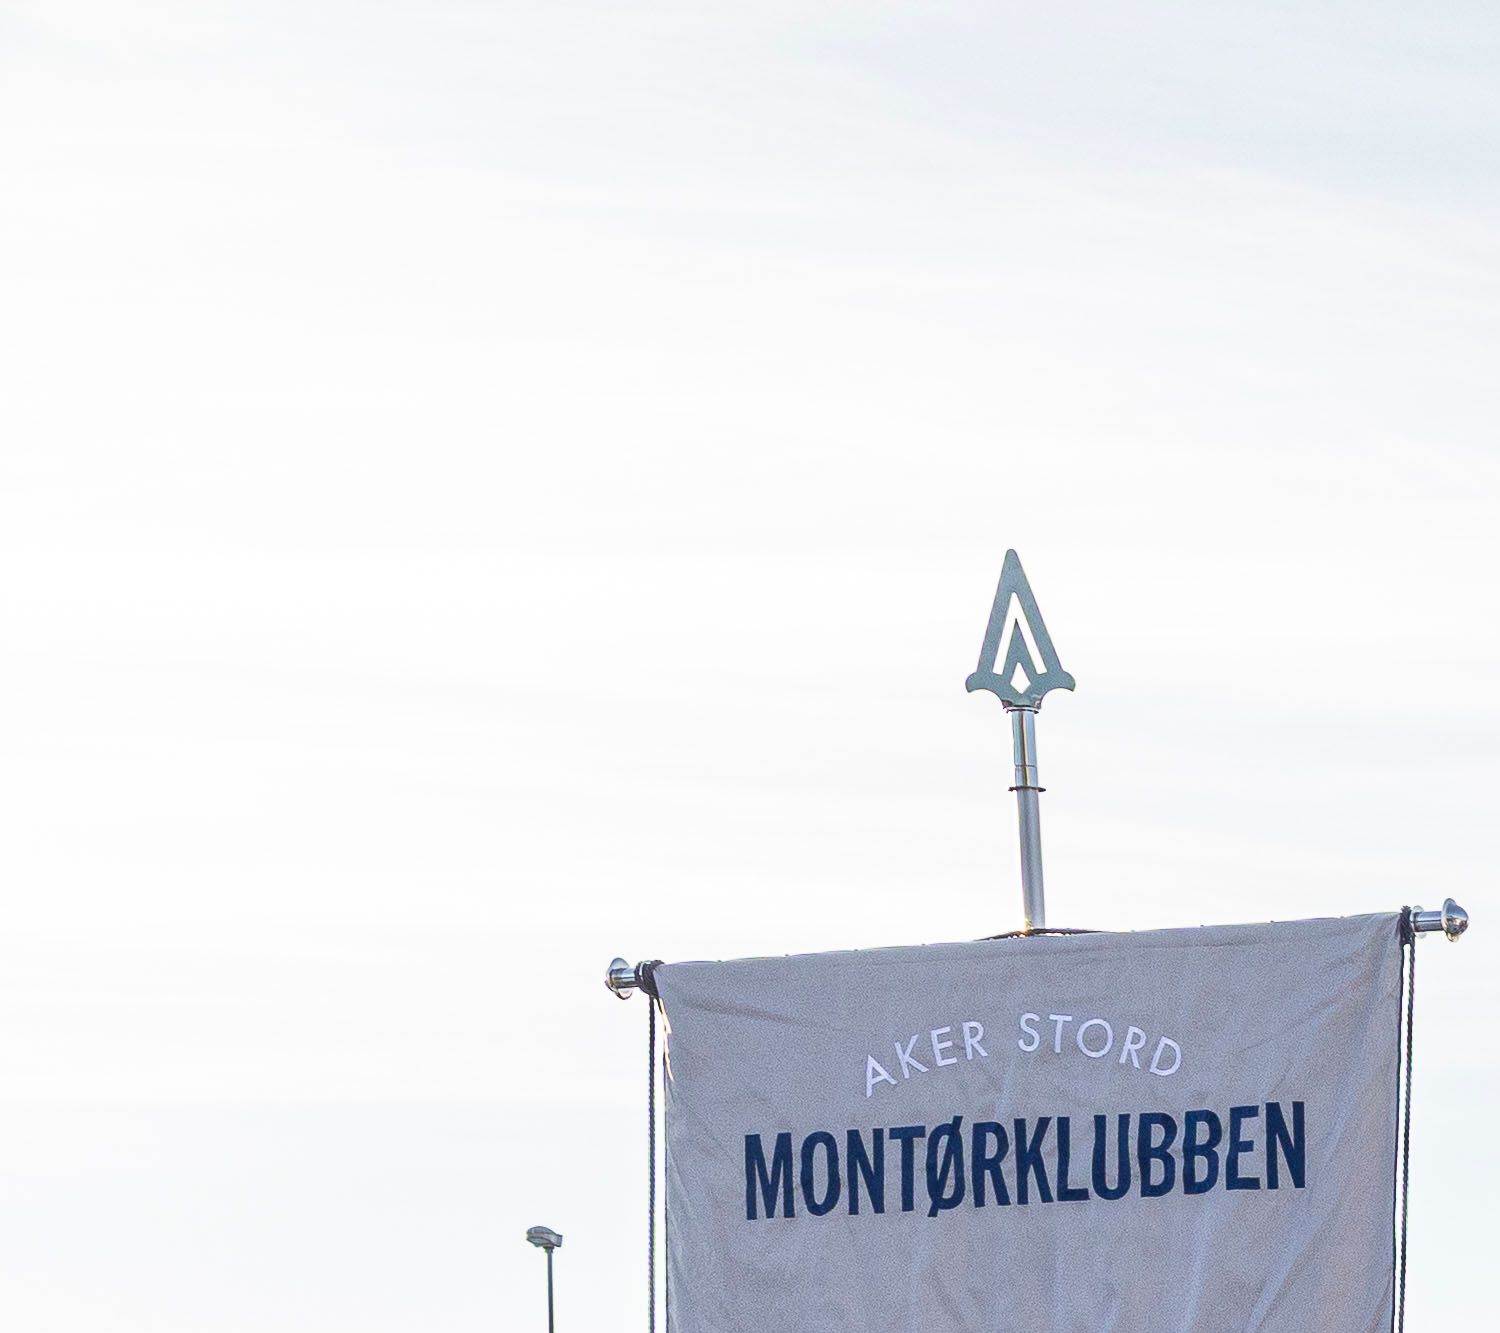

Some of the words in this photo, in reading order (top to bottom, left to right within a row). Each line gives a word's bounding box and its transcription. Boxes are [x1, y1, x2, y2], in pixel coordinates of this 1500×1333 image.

[865, 1020, 988, 1098] AKER
[1018, 1011, 1183, 1078] STORD
[743, 1100, 1306, 1221] MONTØRKLUBBEN
